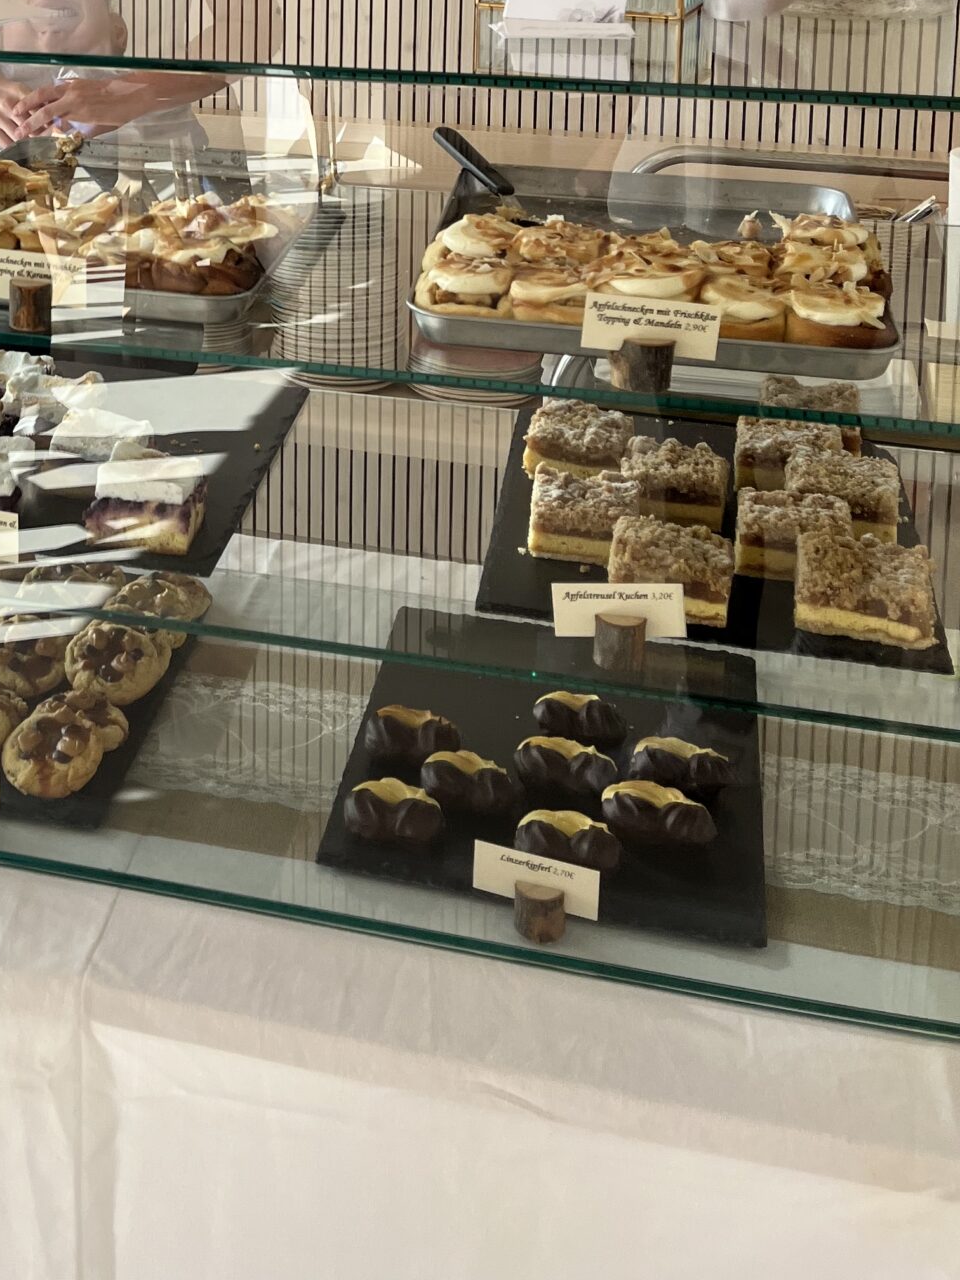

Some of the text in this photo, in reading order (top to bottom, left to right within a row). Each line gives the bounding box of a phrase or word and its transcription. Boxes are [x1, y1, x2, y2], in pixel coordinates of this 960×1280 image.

[589, 300, 718, 322] Apfelschnecken mit Frischkäse
[597, 313, 631, 327] Topping
[644, 318, 682, 330] Mandeln
[562, 590, 674, 602] Apfelstreusel Kuchen 3,20€
[500, 854, 553, 873] Linzerkipferl
